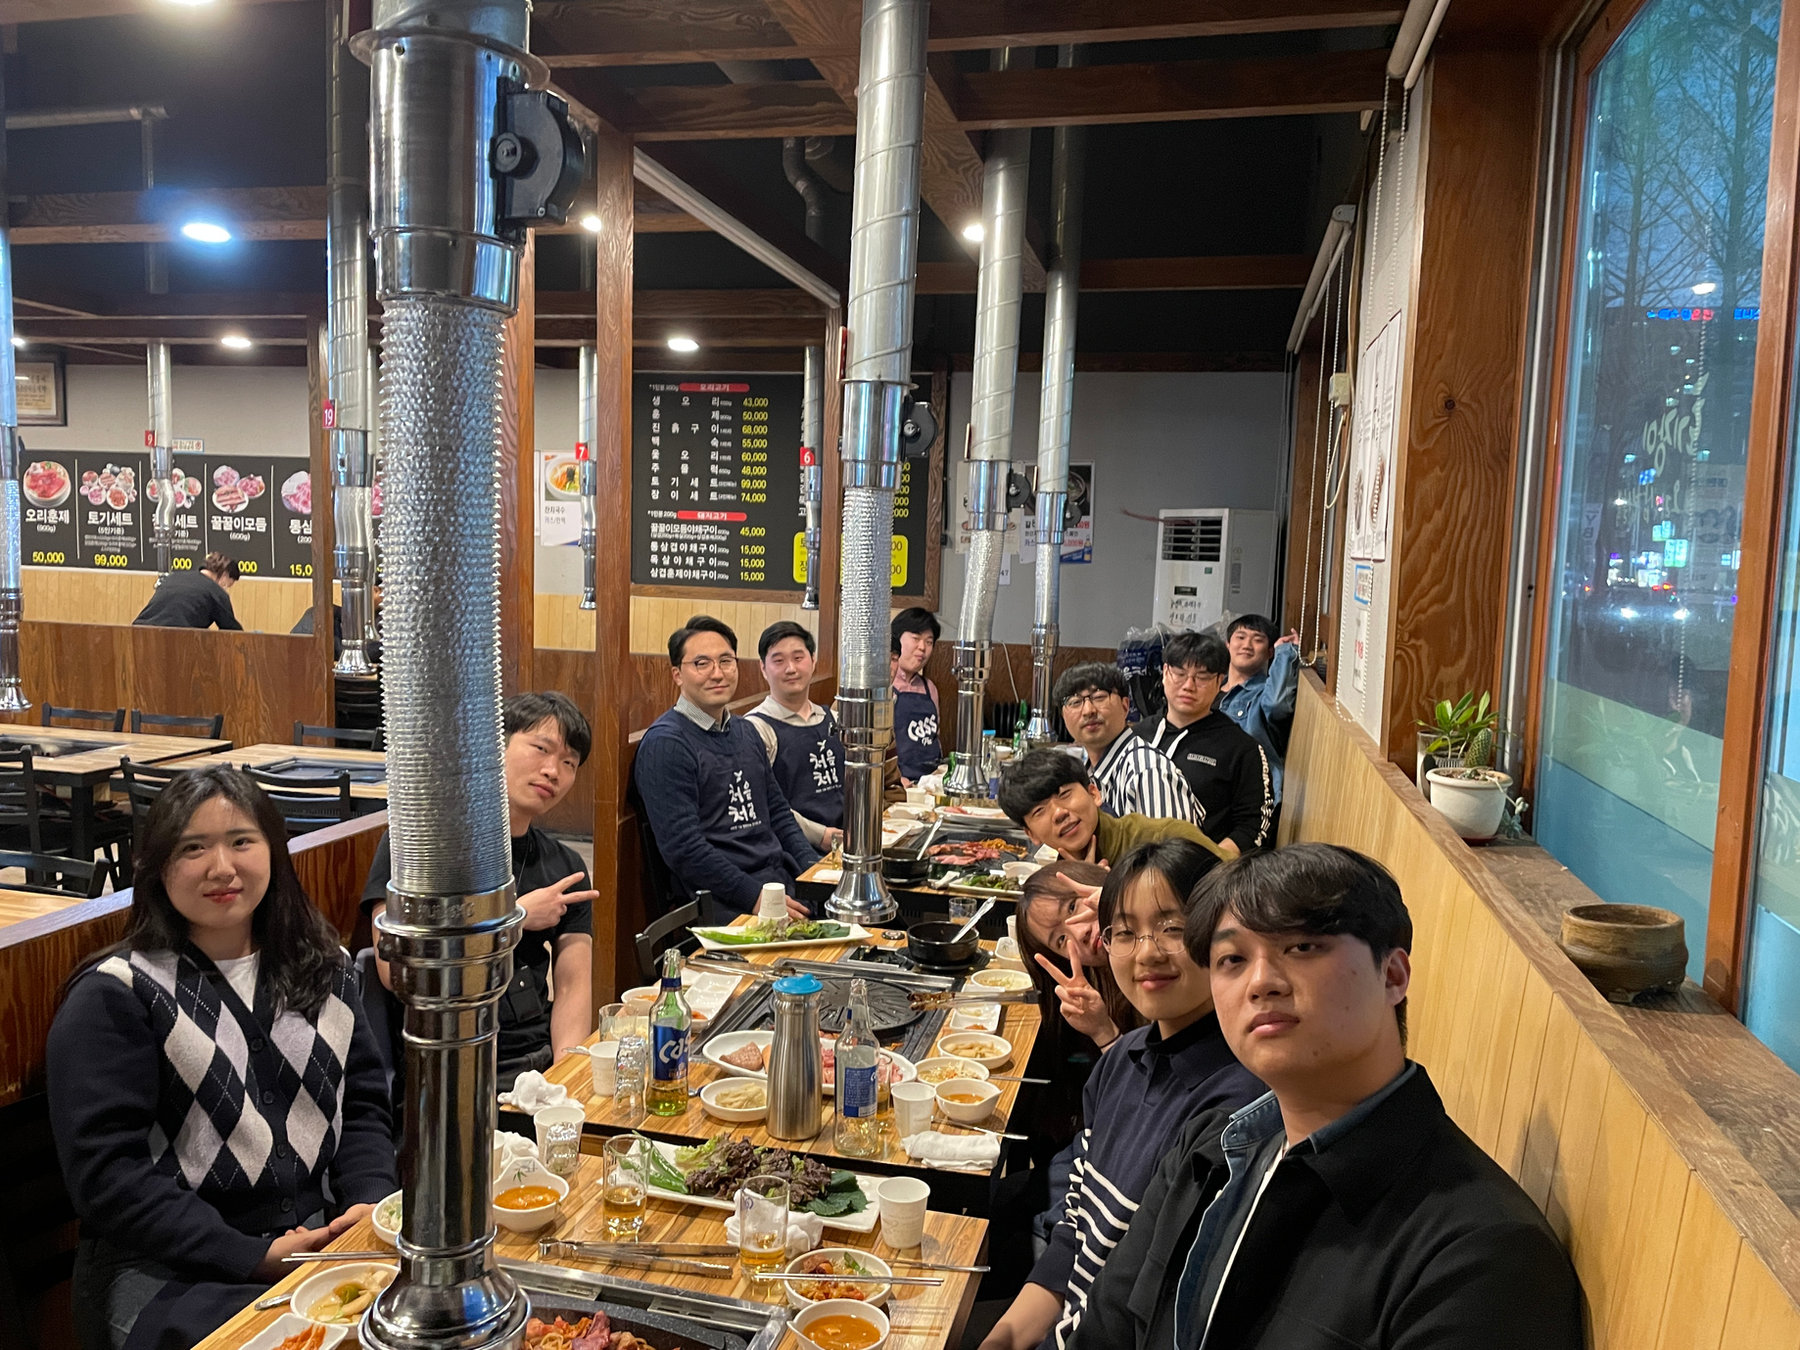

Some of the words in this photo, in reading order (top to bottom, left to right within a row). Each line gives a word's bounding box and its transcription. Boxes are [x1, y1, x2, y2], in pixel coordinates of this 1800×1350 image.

[743, 397, 769, 407] 43,000
[324, 408, 334, 426] 19
[742, 411, 768, 421] 50,000
[742, 424, 768, 435] 68,000
[147, 434, 153, 446] 9
[741, 438, 768, 449] 55,000
[578, 446, 585, 458] 7
[741, 452, 768, 462] 60,000
[803, 451, 811, 464] 6
[741, 465, 767, 476] 48,000
[741, 479, 767, 490] 99,000
[741, 492, 767, 503] 74,000
[25, 508, 70, 525] 오리훈제
[87, 511, 134, 526] 토기세트
[697, 512, 728, 520] 돼지고기
[740, 527, 766, 537] 45,000
[740, 545, 766, 555] 15,000
[32, 552, 65, 564] 50,000
[94, 554, 128, 567] 99,000
[171, 557, 192, 570] ,000
[740, 558, 766, 569] 15,000
[289, 564, 313, 577] 15,0
[740, 571, 765, 582] 15,000
[907, 713, 937, 742] Cass
[809, 749, 836, 769] 처음
[812, 767, 838, 787] 처럼
[728, 780, 752, 804] 처음
[728, 801, 757, 823] 처럼
